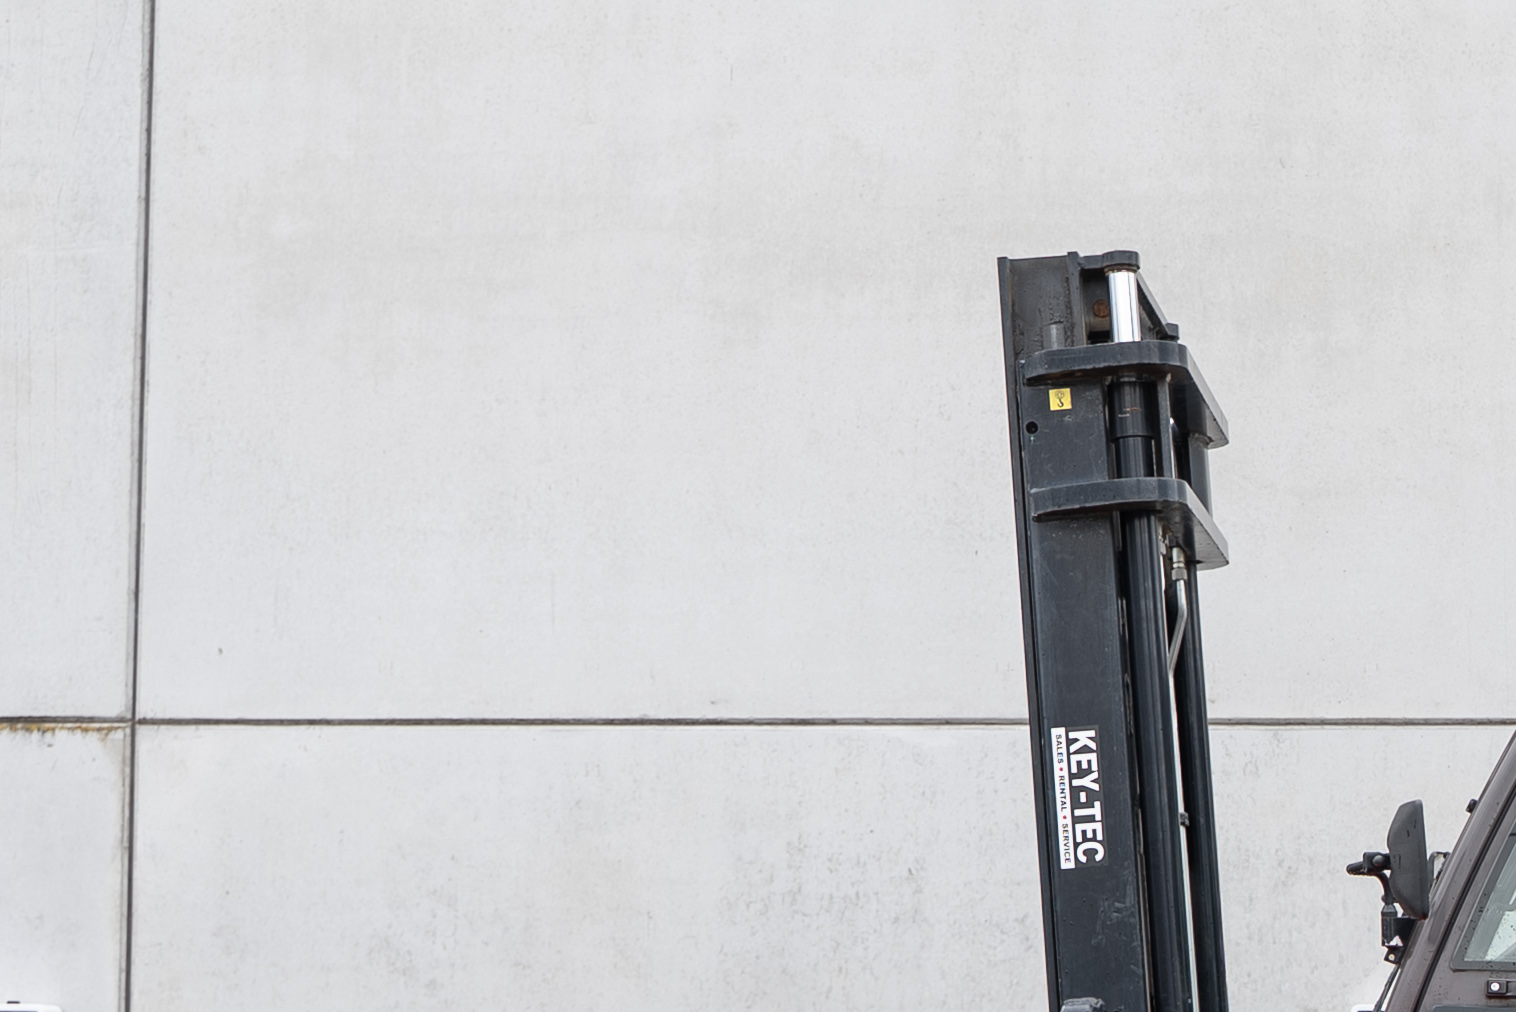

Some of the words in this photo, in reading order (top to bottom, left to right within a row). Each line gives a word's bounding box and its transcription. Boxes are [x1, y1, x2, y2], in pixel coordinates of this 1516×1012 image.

[1055, 733, 1065, 764] SALES
[1058, 774, 1068, 812] RENTAL
[1067, 729, 1105, 864] KEY-TEC
[1061, 822, 1072, 864] SERVICE
